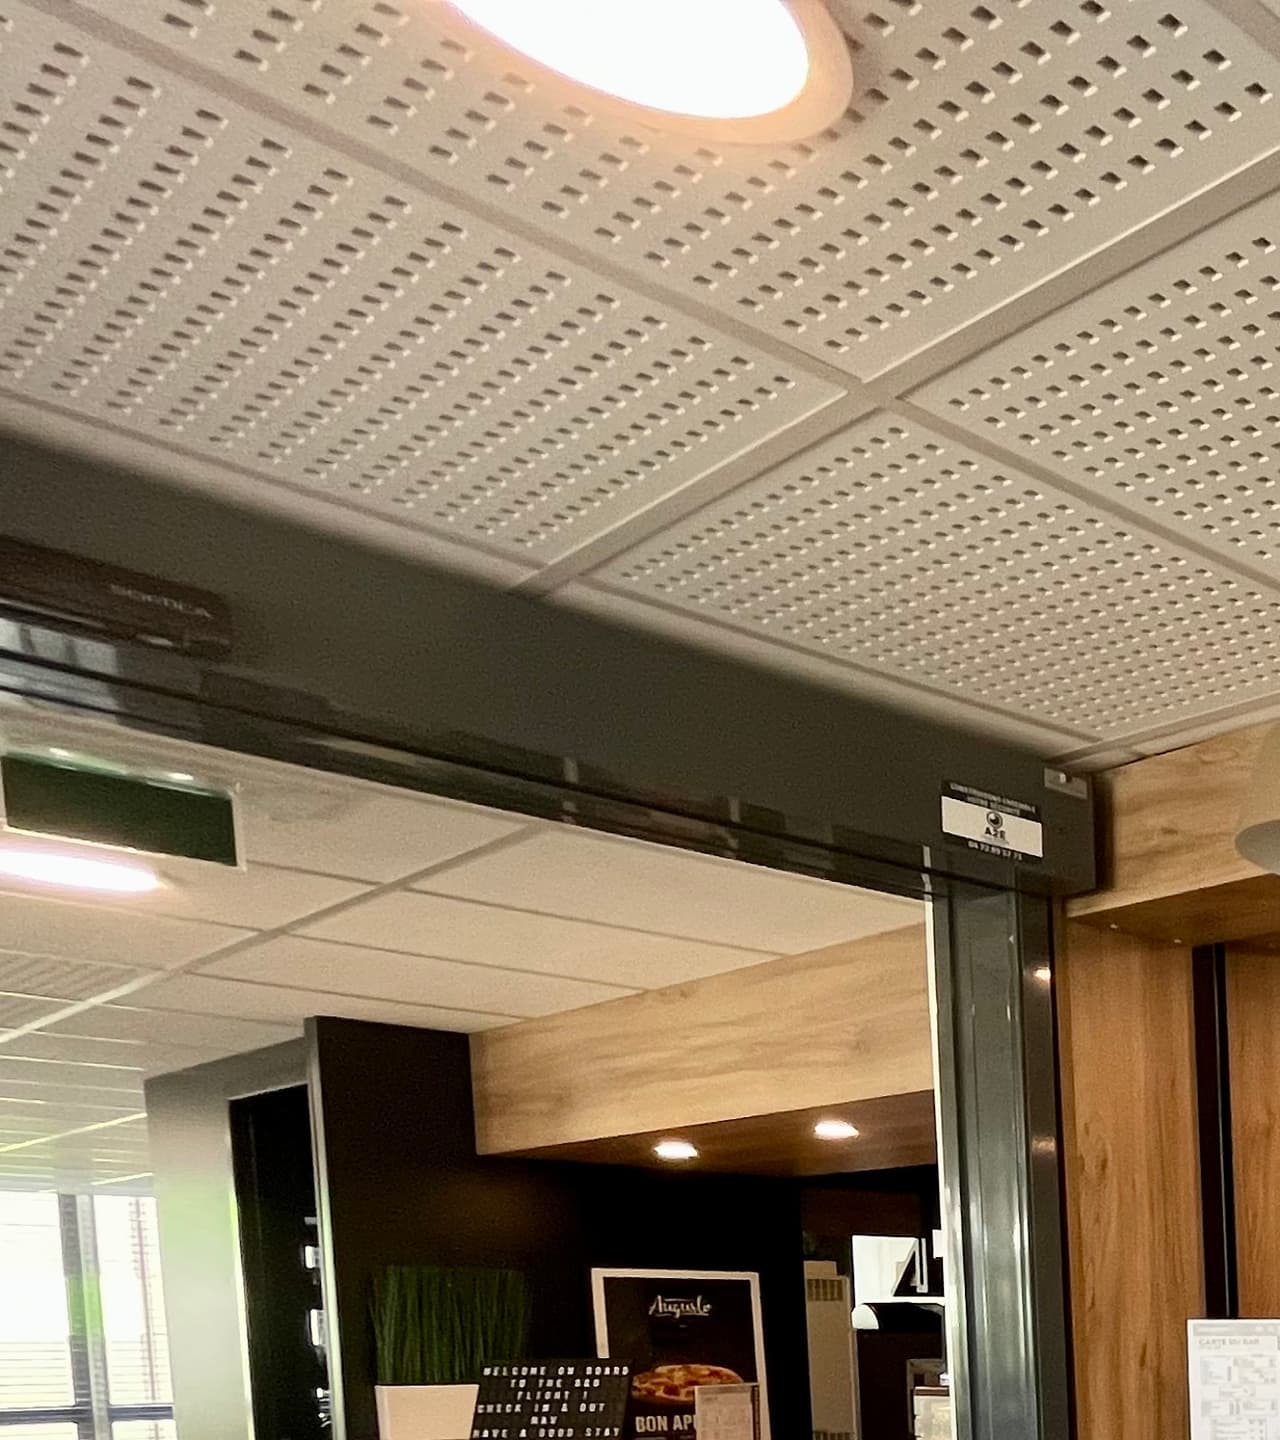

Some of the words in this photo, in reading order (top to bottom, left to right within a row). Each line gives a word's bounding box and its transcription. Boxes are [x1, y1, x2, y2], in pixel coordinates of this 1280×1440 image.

[483, 1366, 547, 1376] WELCOME
[558, 1366, 575, 1376] ON
[585, 1366, 630, 1376] BOARD
[510, 1378, 527, 1388] TO
[538, 1378, 563, 1388] THE
[517, 1390, 570, 1400] FLIGHT
[477, 1403, 523, 1414] CHECK
[534, 1403, 550, 1413] IN
[579, 1402, 606, 1412] OUT
[635, 1415, 668, 1432] BON
[472, 1428, 509, 1438] HAVE
[519, 1428, 527, 1437] A
[538, 1428, 574, 1438] GOOD
[585, 1427, 621, 1437] STAY
